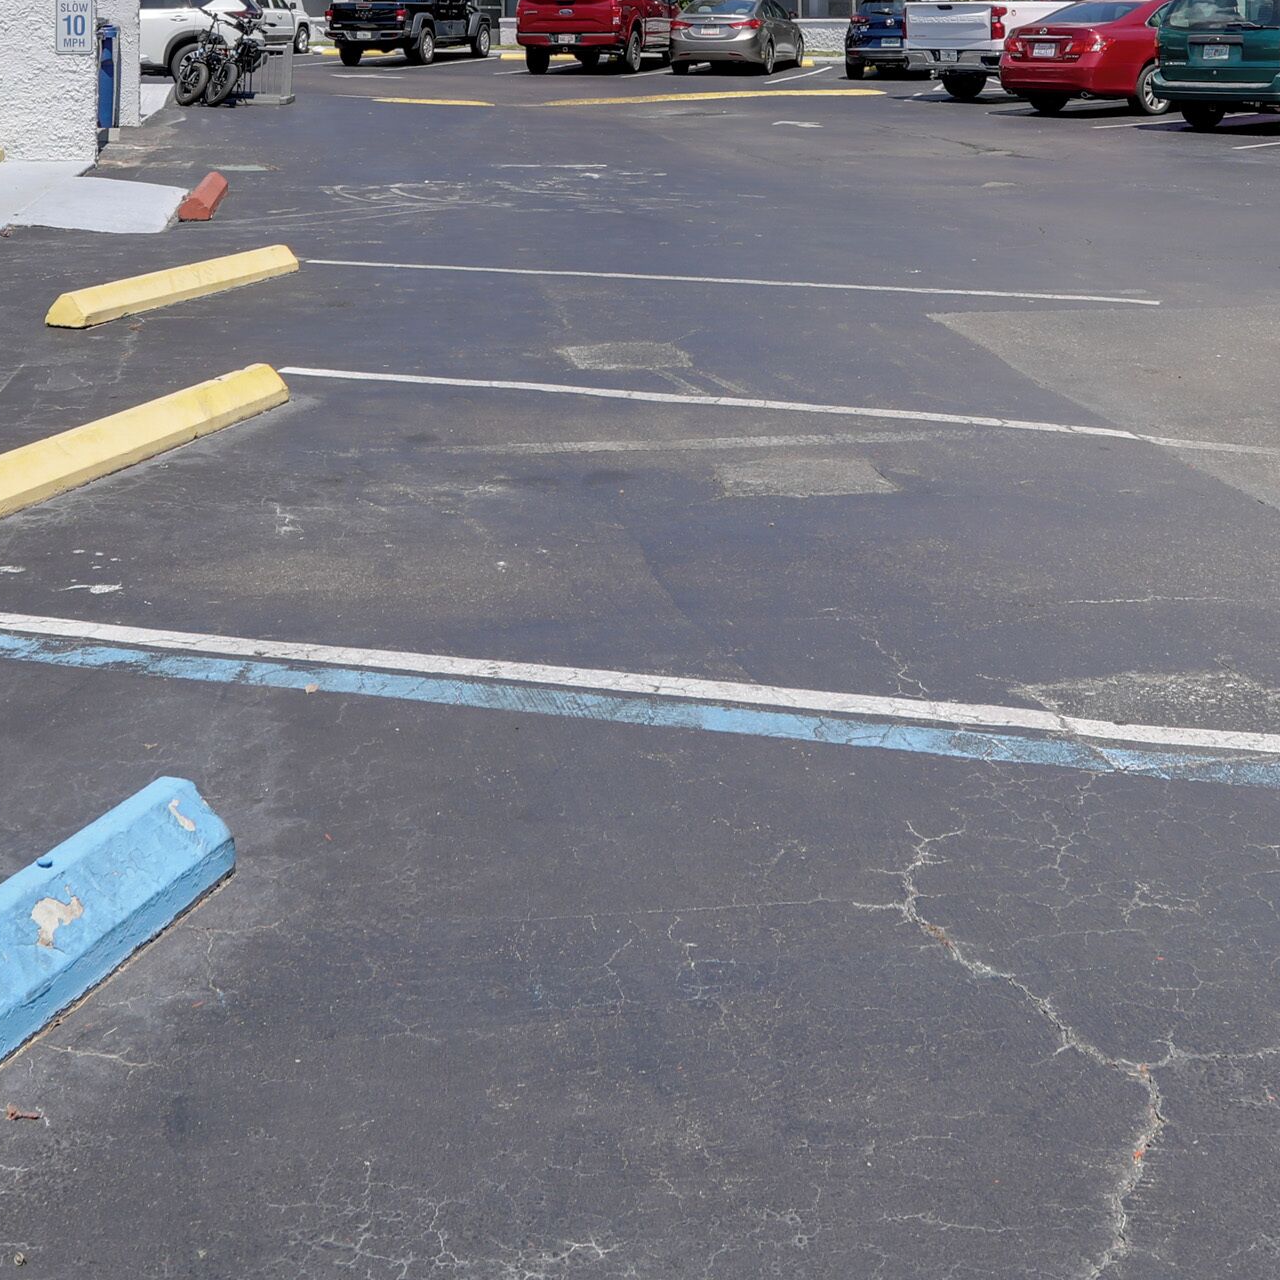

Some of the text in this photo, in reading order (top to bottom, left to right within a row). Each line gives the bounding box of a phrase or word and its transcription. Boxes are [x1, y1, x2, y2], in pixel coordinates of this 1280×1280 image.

[60, 3, 88, 12] SLOW
[62, 15, 85, 36] 10
[63, 38, 85, 47] MPH
